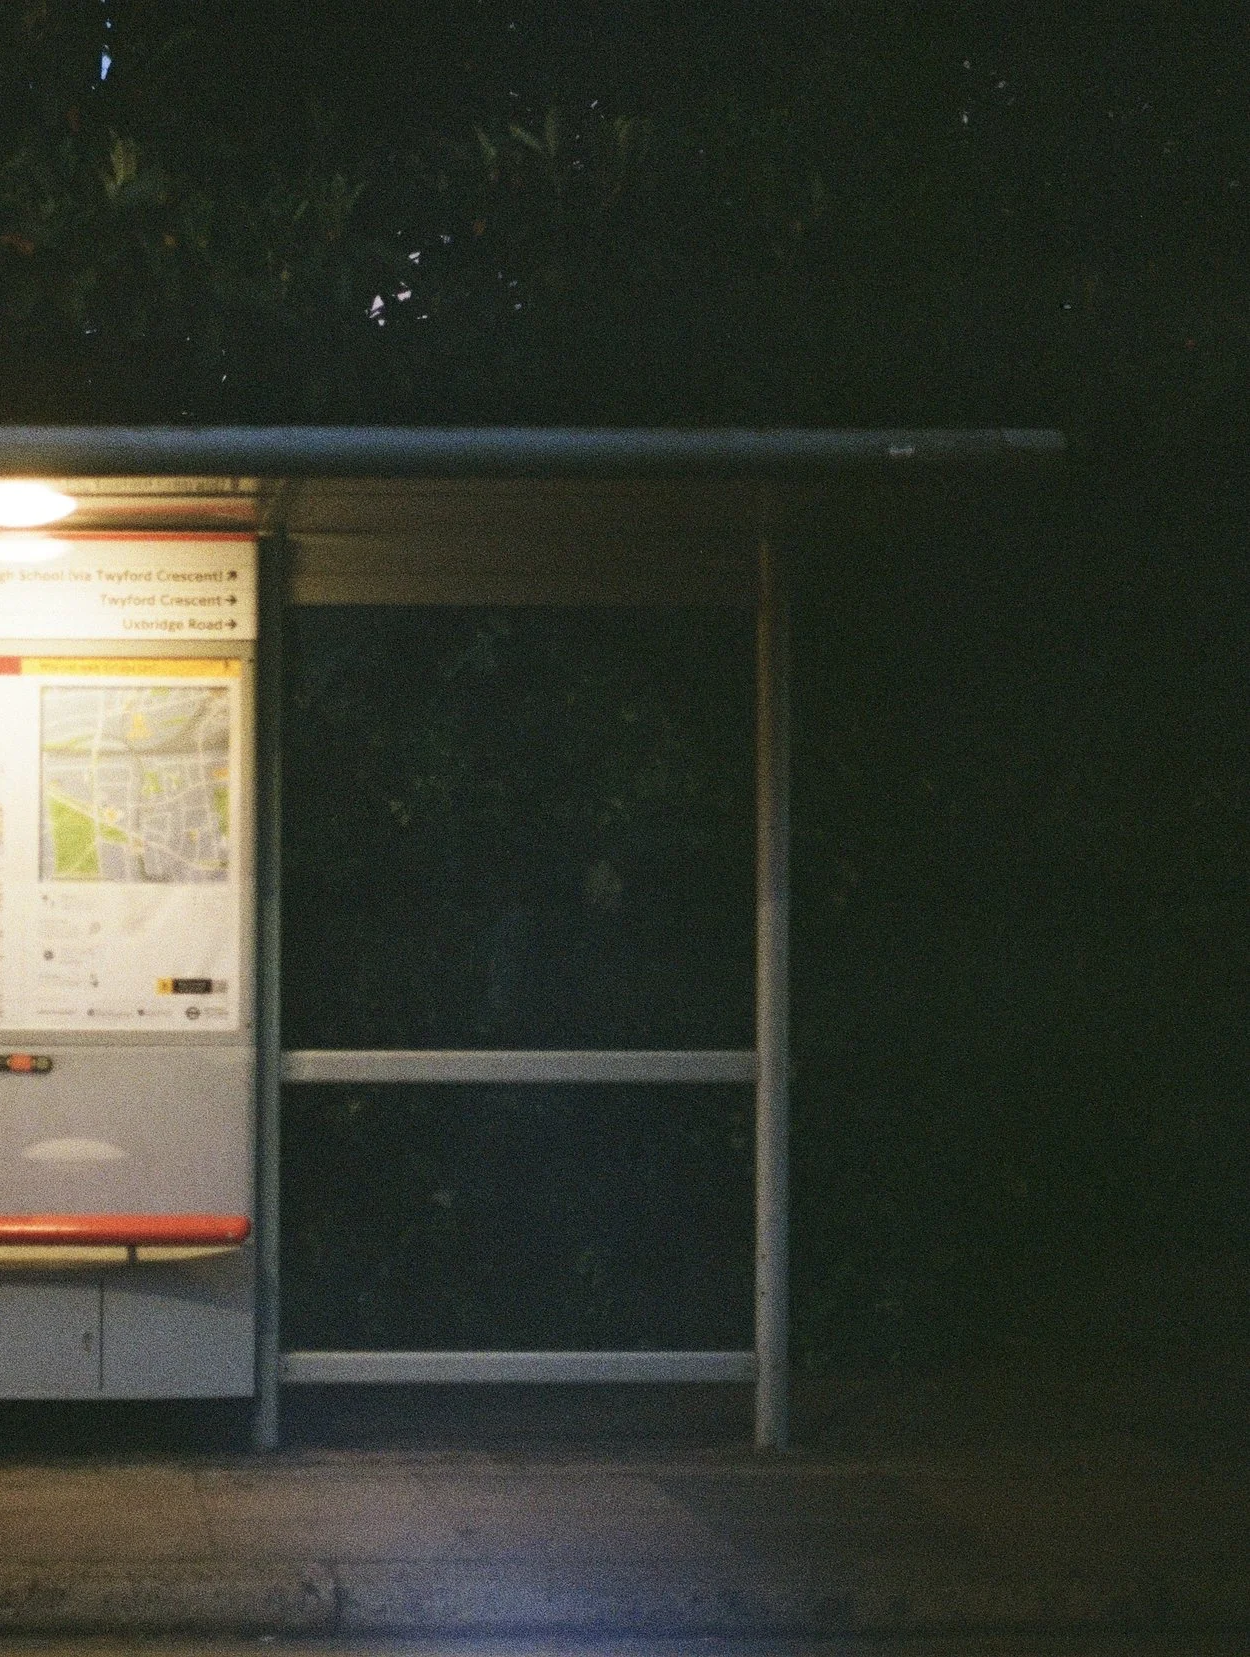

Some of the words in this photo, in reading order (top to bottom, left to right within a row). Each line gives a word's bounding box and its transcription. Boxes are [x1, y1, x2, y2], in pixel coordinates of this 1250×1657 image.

[19, 569, 64, 581] School
[97, 569, 152, 584] Twyford
[101, 594, 155, 608] Twyford
[160, 594, 222, 606] Crescent
[123, 618, 184, 632] Uxbridge
[188, 618, 223, 630] Road
